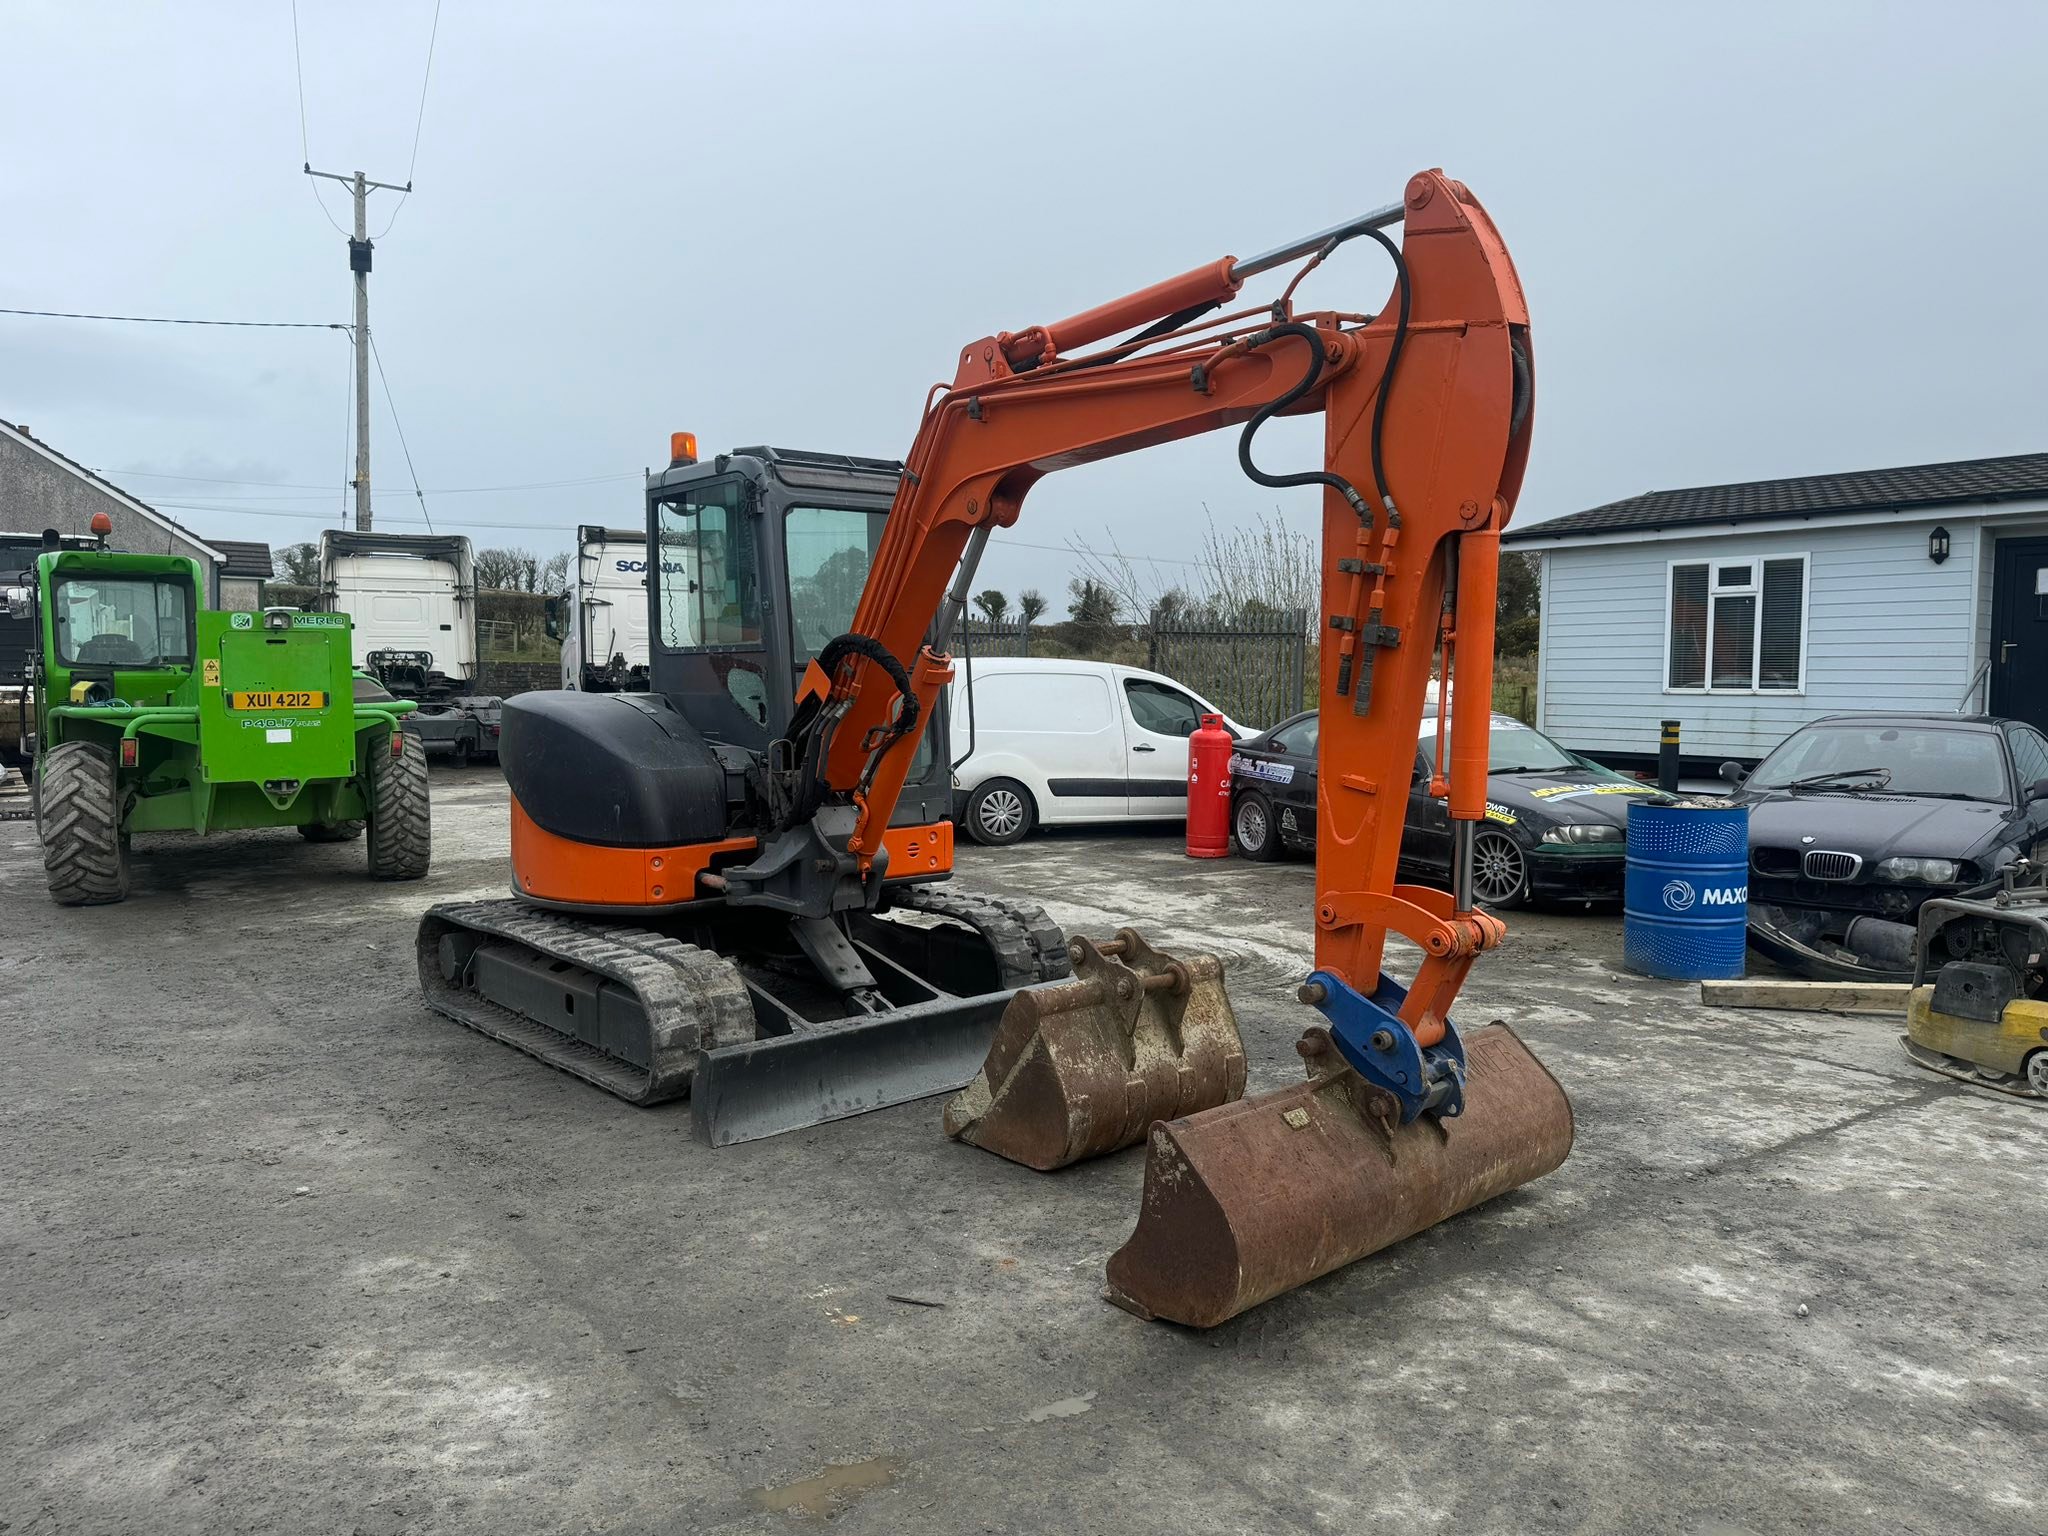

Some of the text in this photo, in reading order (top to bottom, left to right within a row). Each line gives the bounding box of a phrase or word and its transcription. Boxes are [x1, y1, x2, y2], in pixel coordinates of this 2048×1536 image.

[293, 615, 345, 625] MERLO
[247, 693, 311, 707] XUI 4212
[241, 718, 297, 728] P40.17
